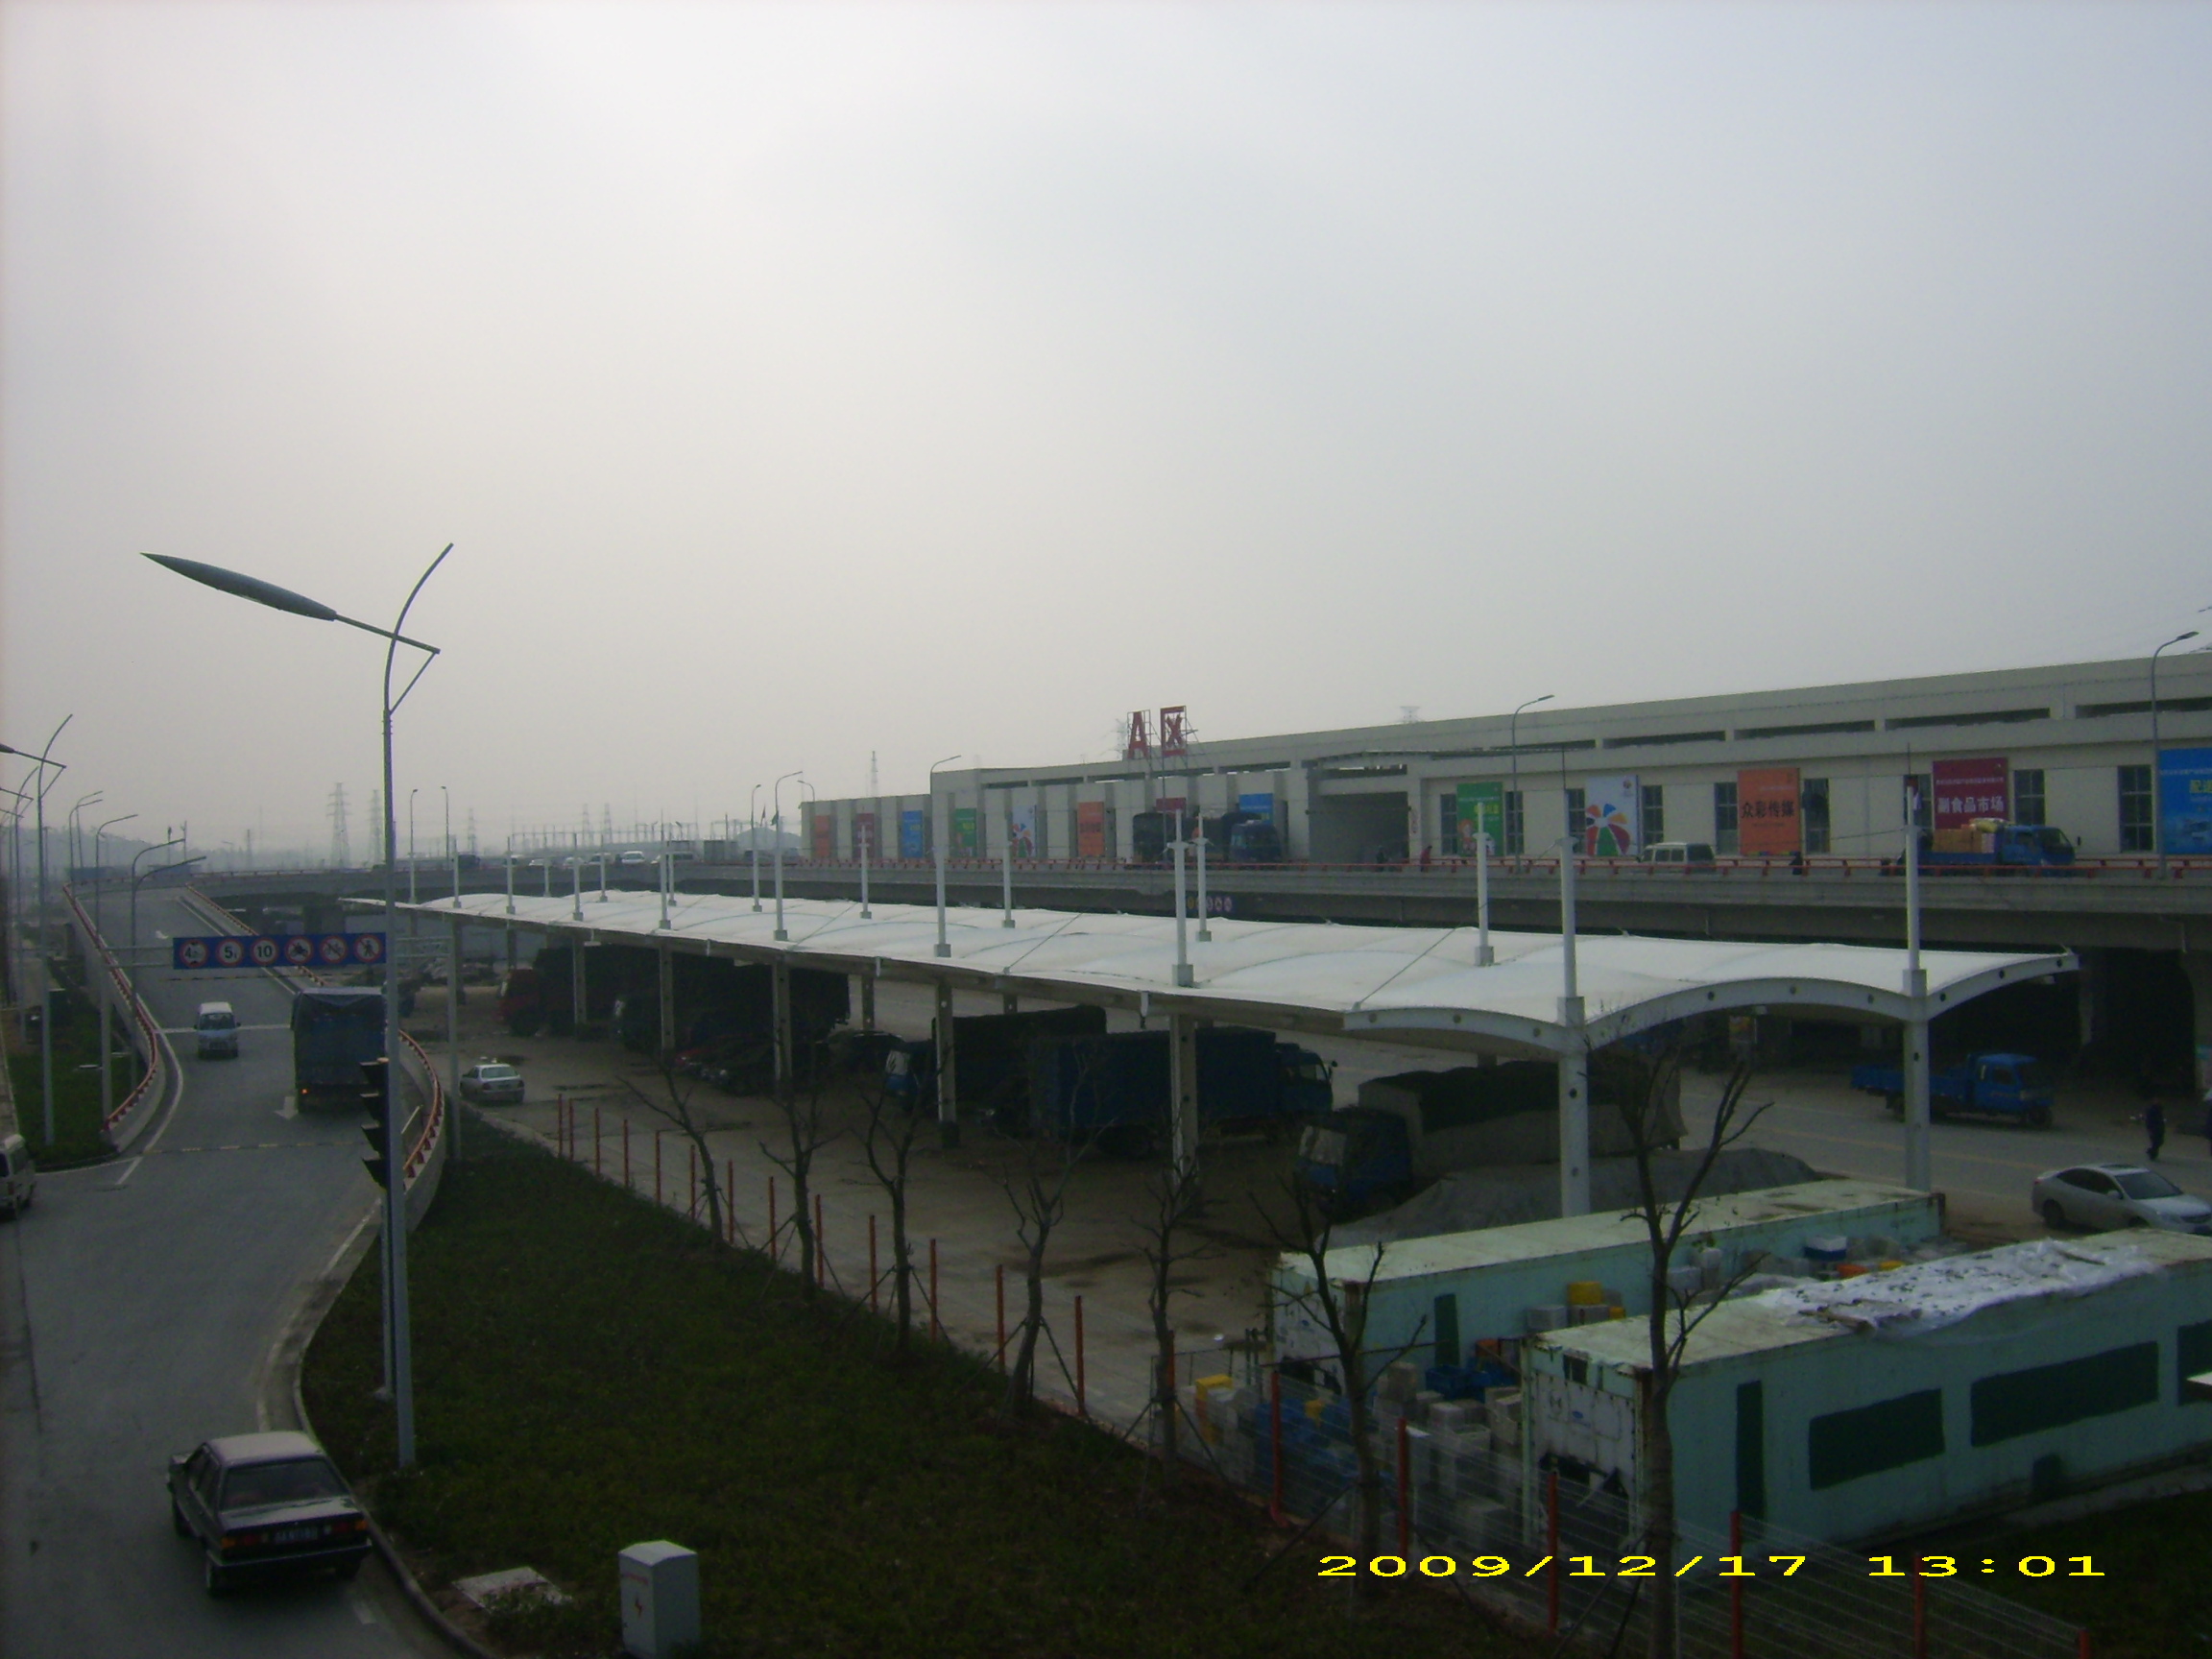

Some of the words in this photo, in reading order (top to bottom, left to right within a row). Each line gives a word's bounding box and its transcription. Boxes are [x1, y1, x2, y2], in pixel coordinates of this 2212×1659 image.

[1937, 796, 2005, 814] 副食品市场
[256, 945, 273, 957] 10
